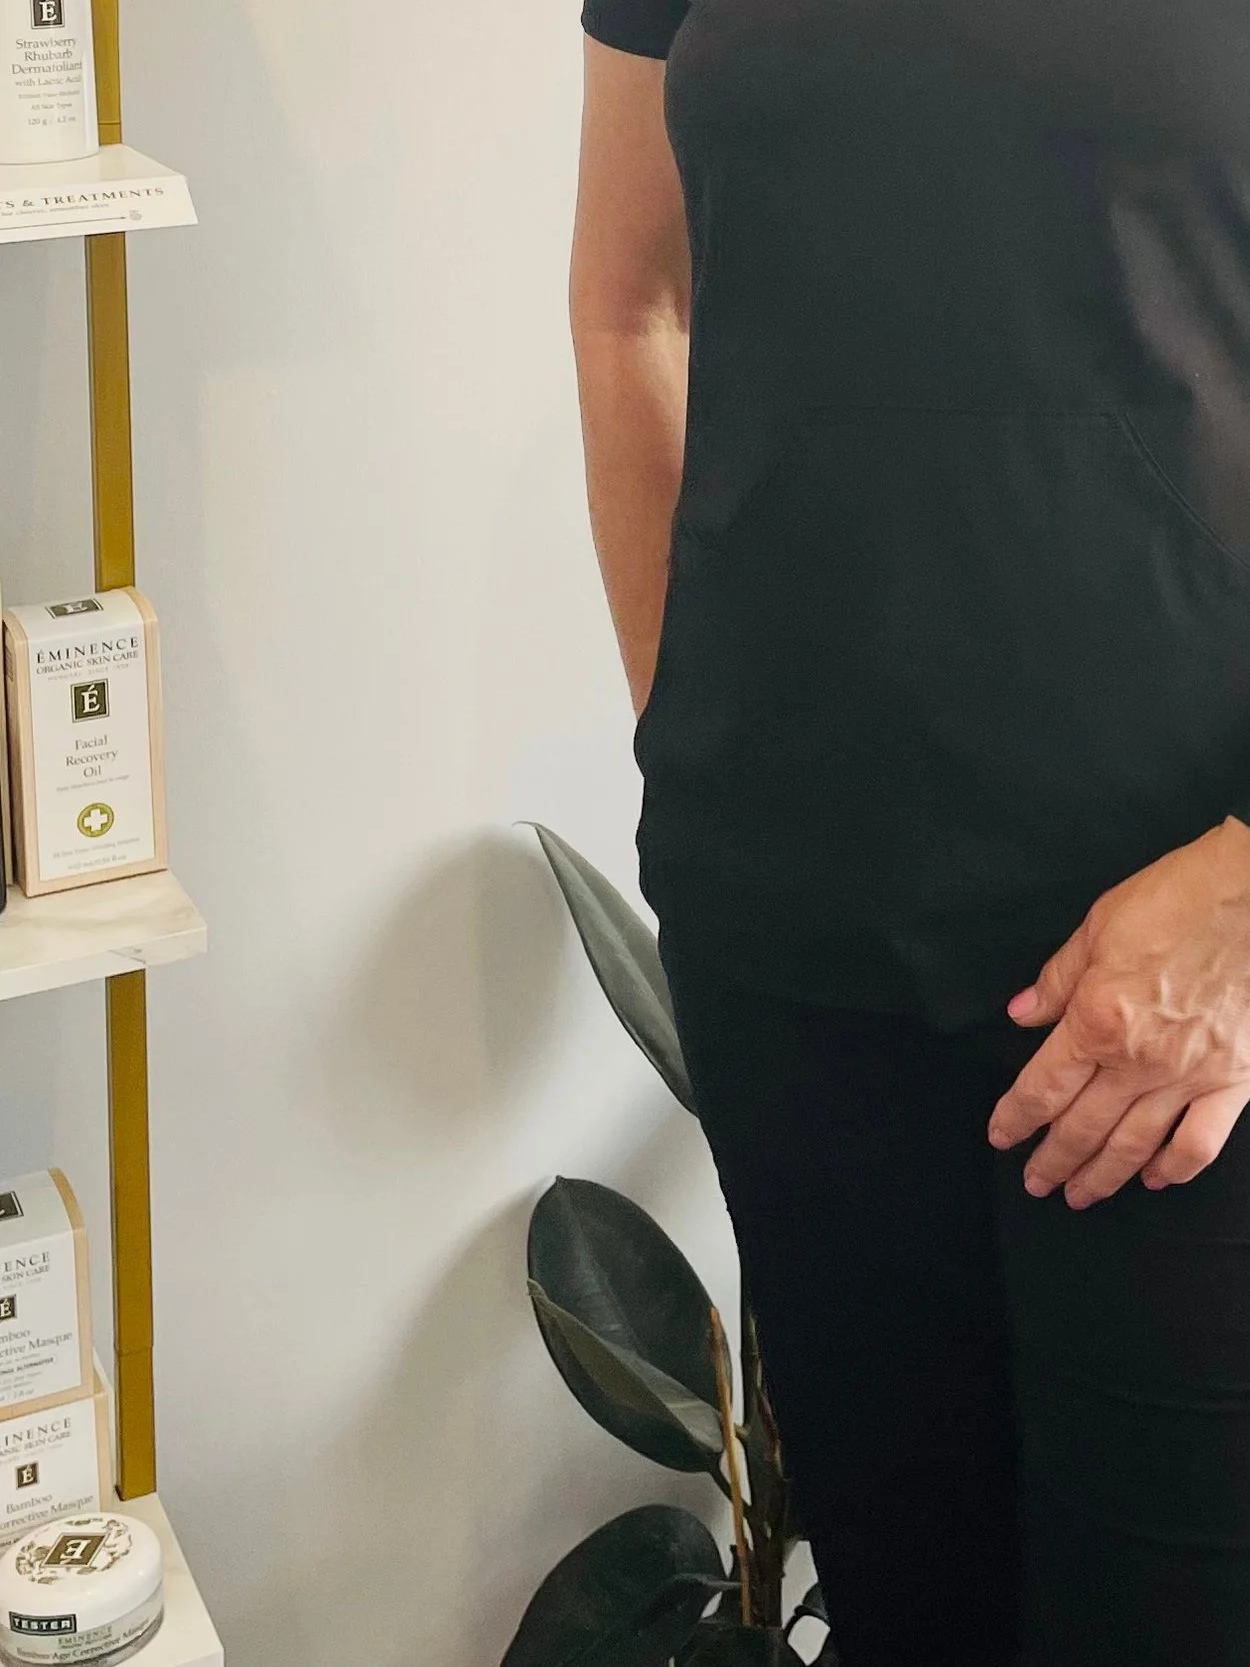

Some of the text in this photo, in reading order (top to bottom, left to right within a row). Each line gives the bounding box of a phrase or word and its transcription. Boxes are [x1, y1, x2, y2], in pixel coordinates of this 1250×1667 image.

[15, 36, 77, 50] Strawberry
[24, 49, 73, 62] Rhubarb
[22, 199, 34, 207] &
[41, 187, 165, 206] TREATMENTS
[36, 636, 139, 665] ÉMINENCE
[36, 661, 85, 675] ORGANIC
[87, 655, 111, 666] SKIN
[113, 650, 139, 662] CARE
[81, 684, 101, 713] É
[75, 734, 108, 751] Facial
[65, 749, 118, 767] Recovery
[83, 765, 102, 778] Oil
[4, 1251, 51, 1273] ENCE
[29, 1332, 73, 1351] Masque
[5, 1417, 71, 1446] INENCE
[0, 1495, 94, 1530] orrective Masque
[6, 1494, 53, 1514] Bamboo
[13, 1618, 72, 1631] TESTER
